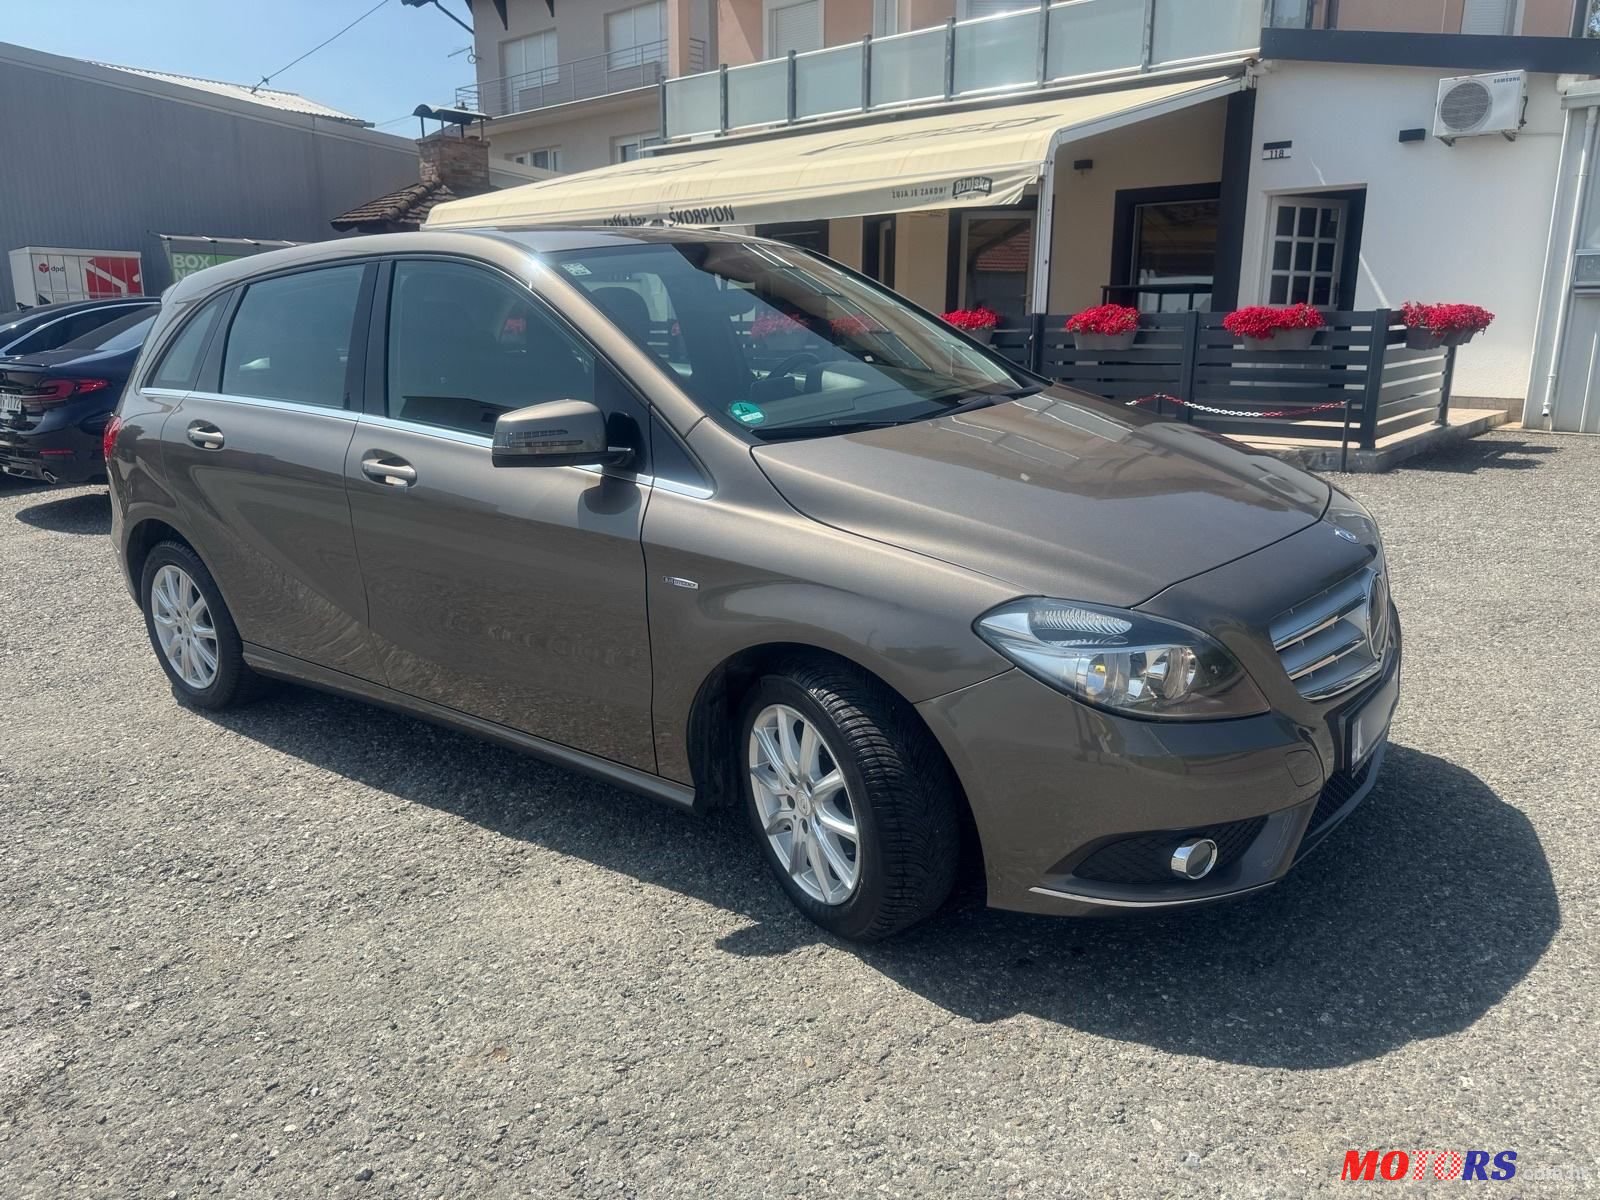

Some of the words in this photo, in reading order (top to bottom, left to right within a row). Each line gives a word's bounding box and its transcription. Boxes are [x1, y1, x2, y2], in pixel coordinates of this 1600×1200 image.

[1493, 76, 1521, 84] SAMSUNG
[1270, 149, 1285, 159] 118
[668, 205, 735, 227] ŠKORPION
[173, 254, 209, 269] BOX
[50, 265, 65, 273] dpd
